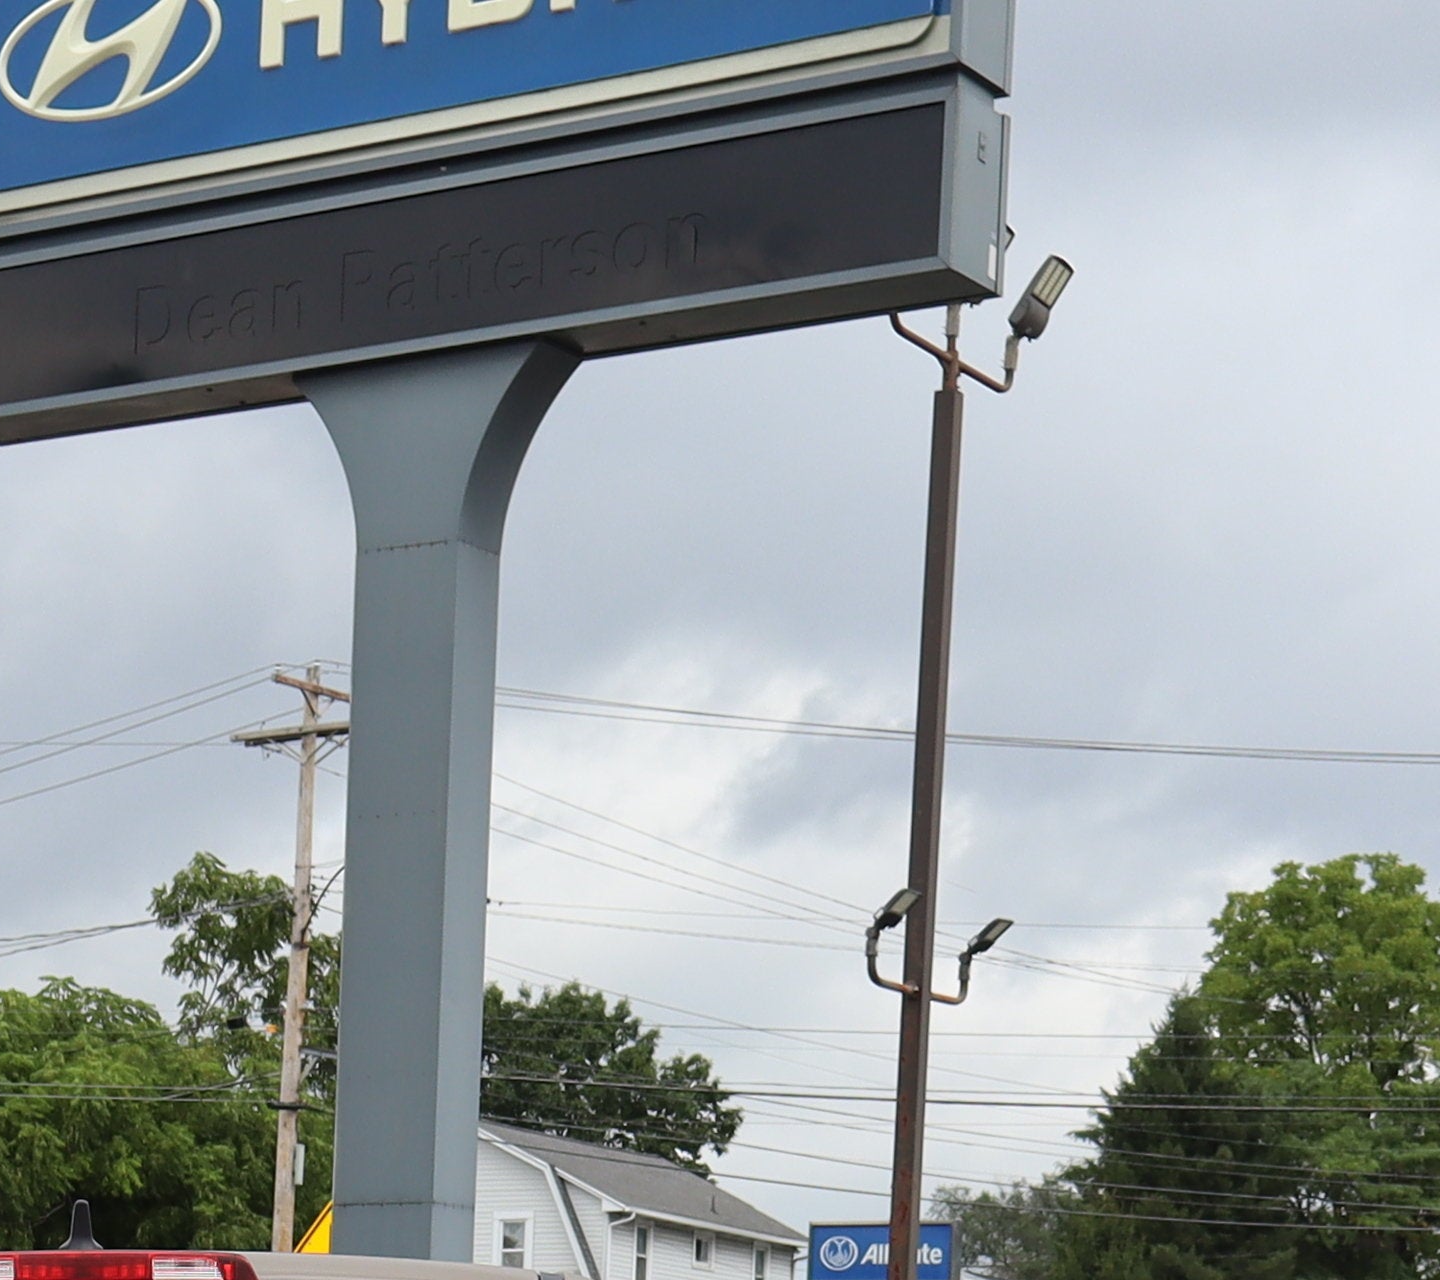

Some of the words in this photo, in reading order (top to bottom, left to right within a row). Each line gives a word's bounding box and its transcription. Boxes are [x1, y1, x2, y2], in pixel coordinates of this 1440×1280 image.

[134, 279, 303, 355] Dean
[338, 211, 708, 323] Patterson
[860, 1243, 943, 1265] Allte
